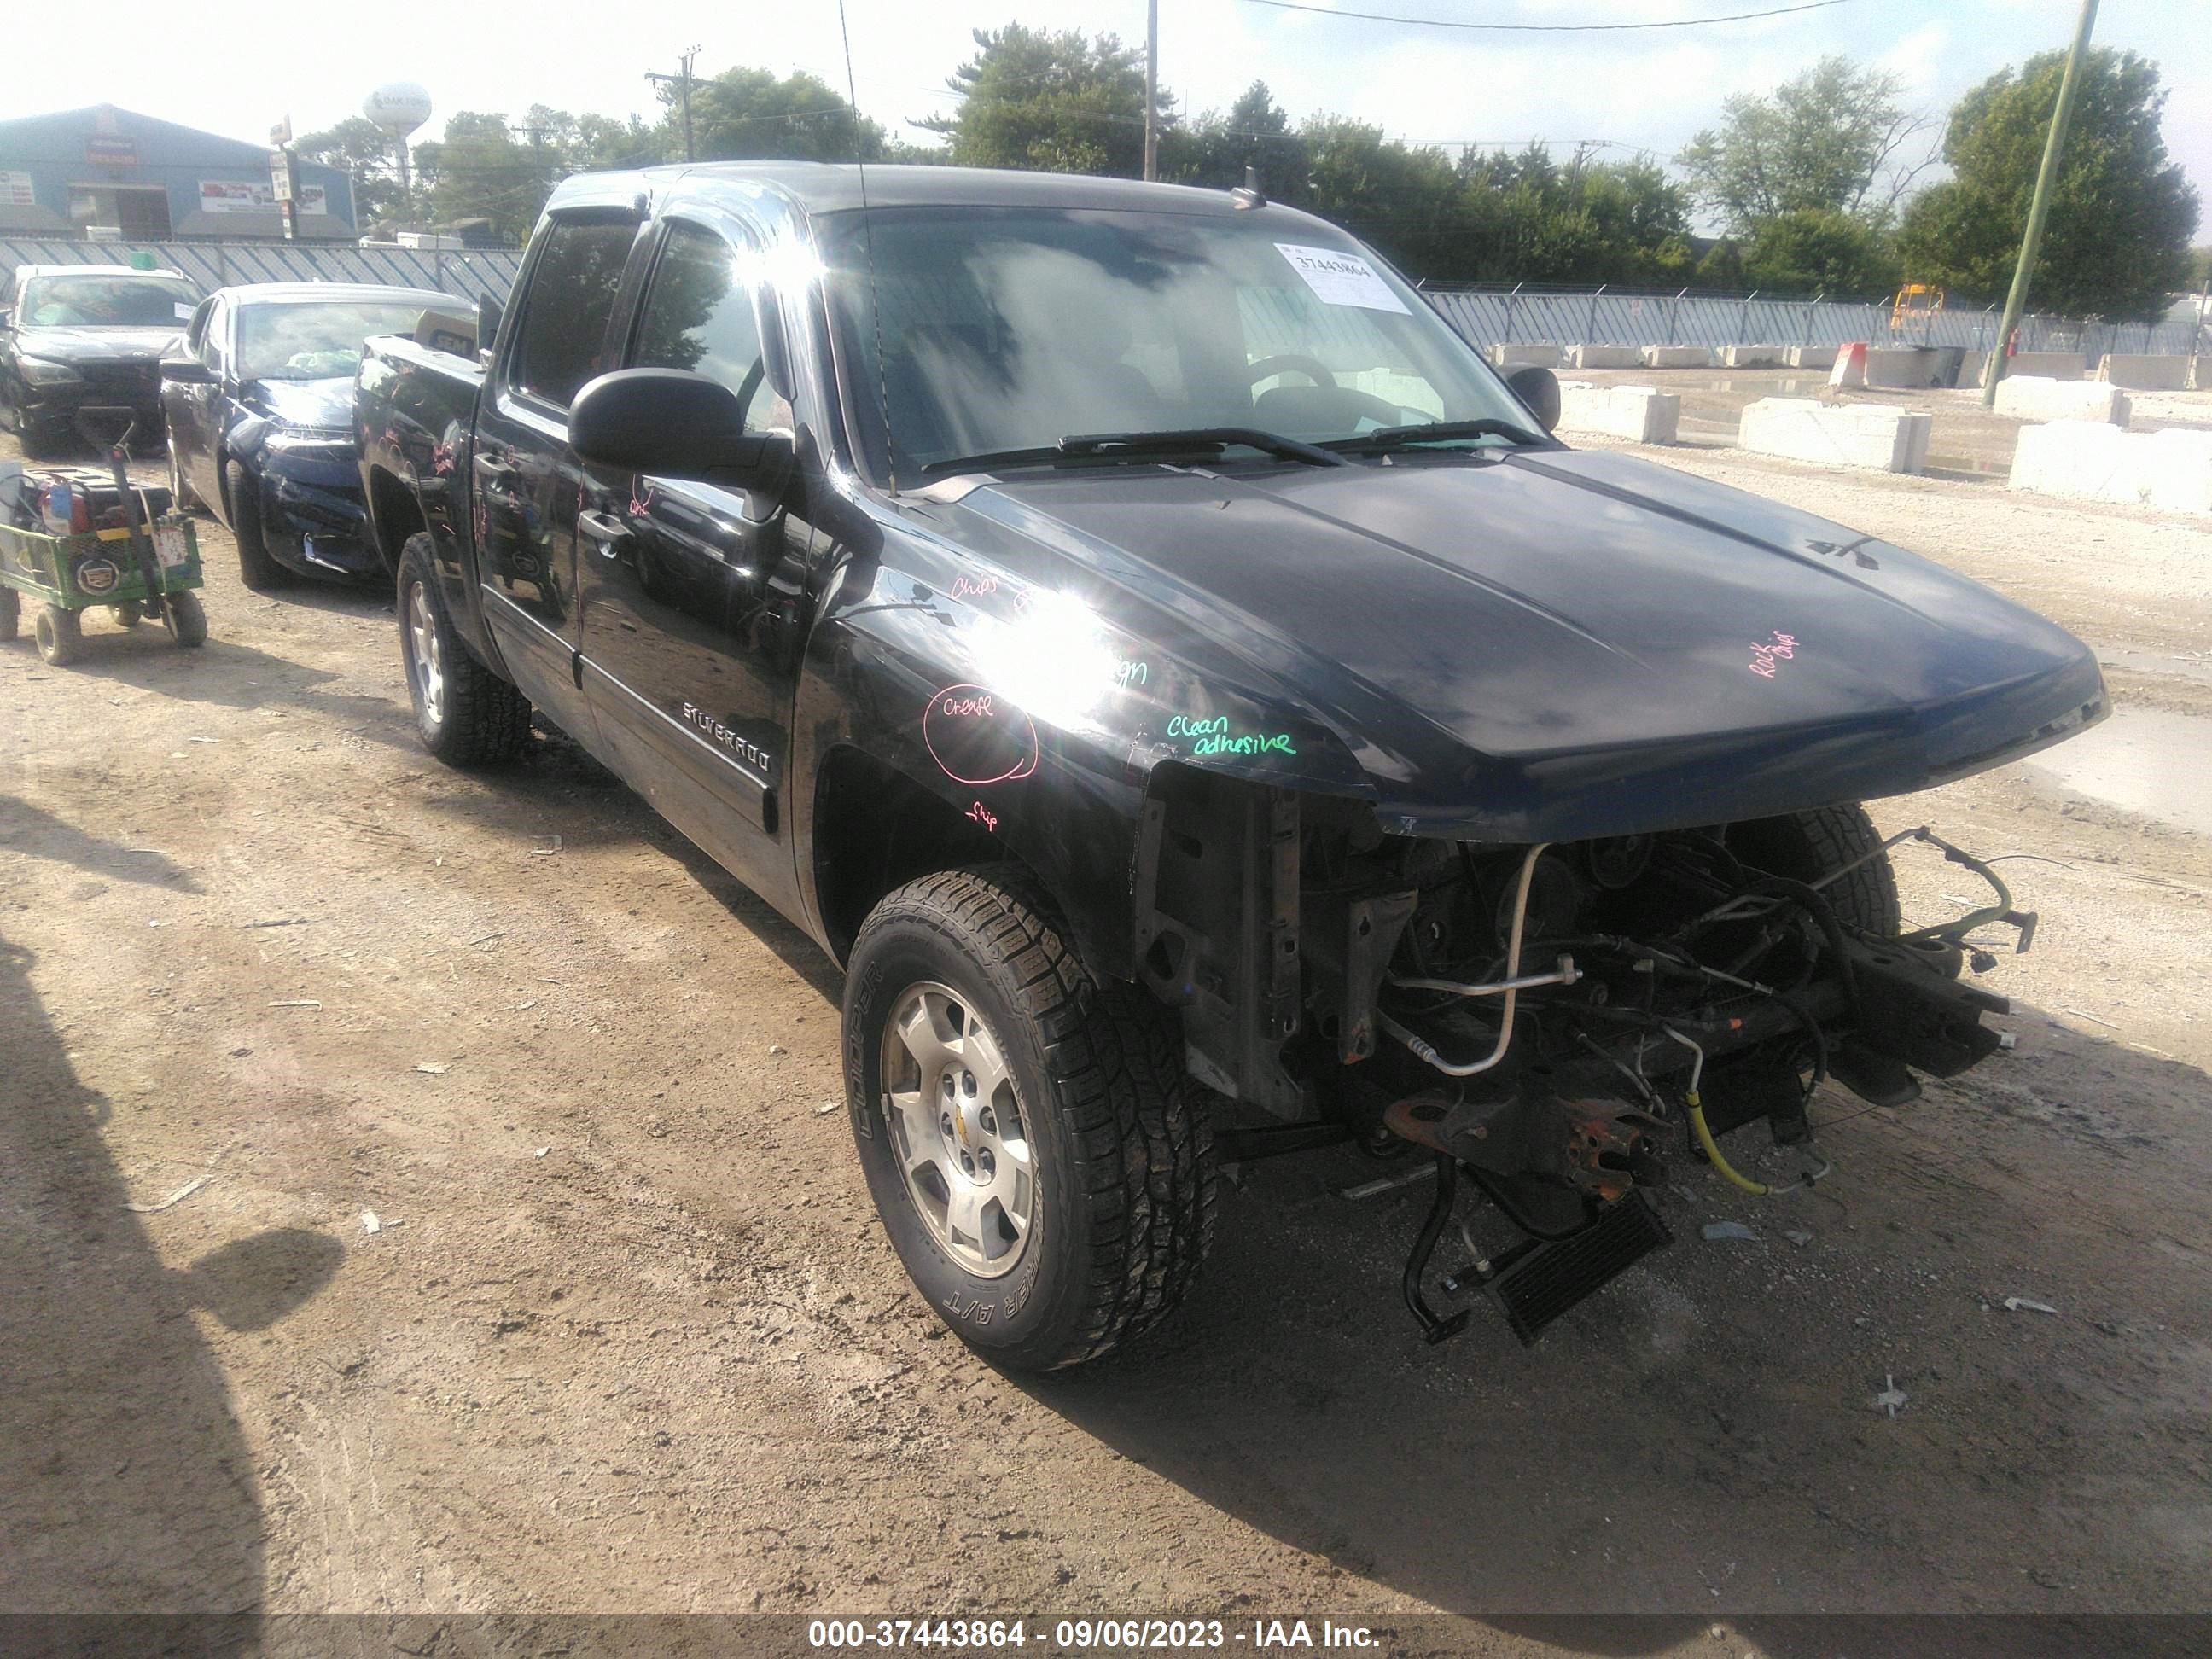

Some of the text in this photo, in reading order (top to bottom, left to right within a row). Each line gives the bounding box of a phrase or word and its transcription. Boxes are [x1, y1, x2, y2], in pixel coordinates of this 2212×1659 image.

[1295, 256, 1371, 278] 37443864
[683, 702, 771, 772] SILVERADO
[941, 1290, 996, 1325] A/T
